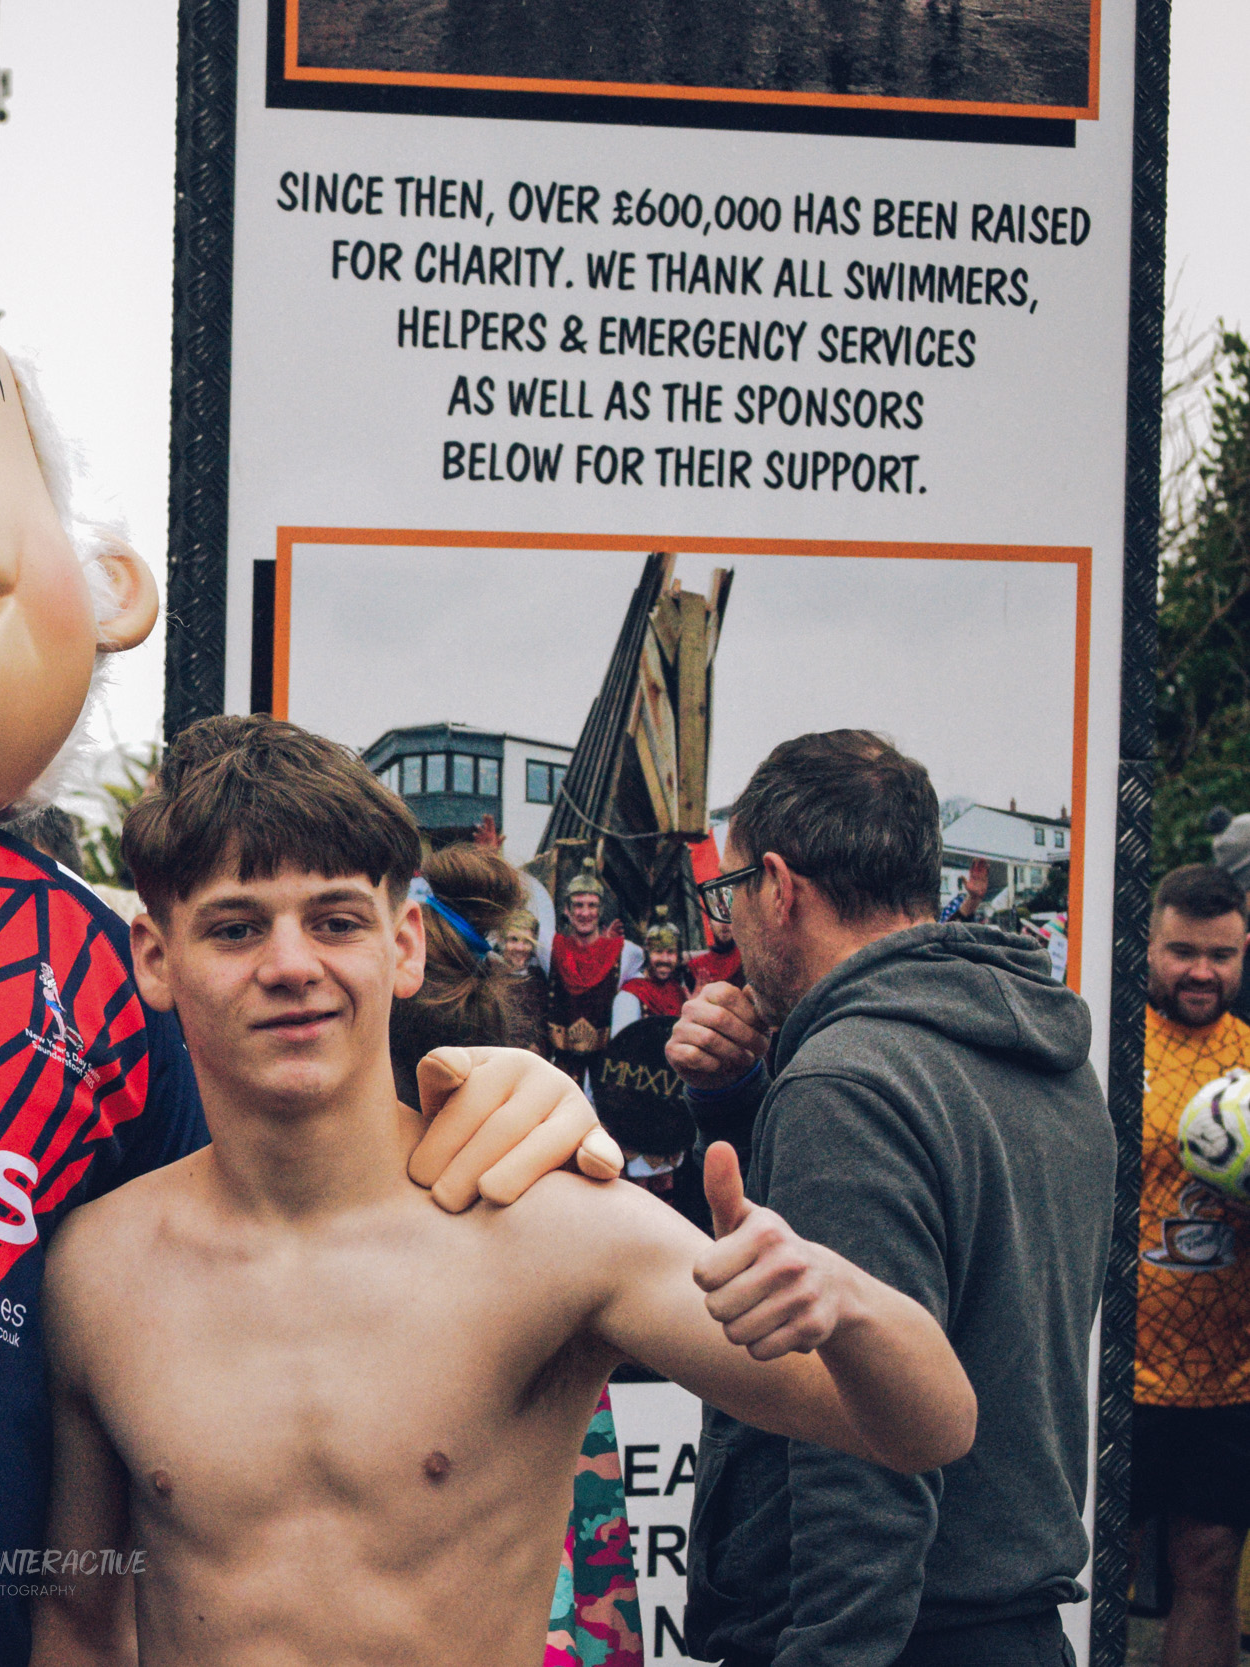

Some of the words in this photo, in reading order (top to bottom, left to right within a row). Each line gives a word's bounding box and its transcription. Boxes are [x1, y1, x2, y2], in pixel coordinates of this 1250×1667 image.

[276, 171, 384, 216] SINCE
[394, 176, 494, 227] THEN,
[508, 181, 601, 225] OVER
[612, 188, 782, 236] £600,000
[793, 192, 861, 236] HAS
[873, 198, 958, 241] BEEN
[971, 203, 1091, 247] RAISED
[332, 239, 403, 282] FOR
[414, 241, 574, 289] CHARITY.
[586, 249, 636, 291] WE
[646, 252, 764, 296] THANK
[773, 257, 833, 299] ALL
[843, 260, 1038, 315] SWIMMERS,
[397, 305, 547, 353] HELPERS
[559, 314, 588, 354] &
[599, 316, 808, 362] EMERGENCY
[817, 323, 976, 369] SERVICES
[447, 375, 495, 416] AS
[508, 377, 594, 419] WELL
[604, 380, 651, 421] AS
[661, 381, 723, 424] THE
[734, 384, 924, 430] SPONSORS
[442, 440, 564, 483] BELOW
[576, 444, 645, 486] FOR
[654, 445, 753, 489] THEIR
[763, 450, 927, 495] SUPPORT.
[25, 1028, 46, 1044] New
[72, 1052, 87, 1069] Day
[31, 1040, 84, 1077] Saundersfoot
